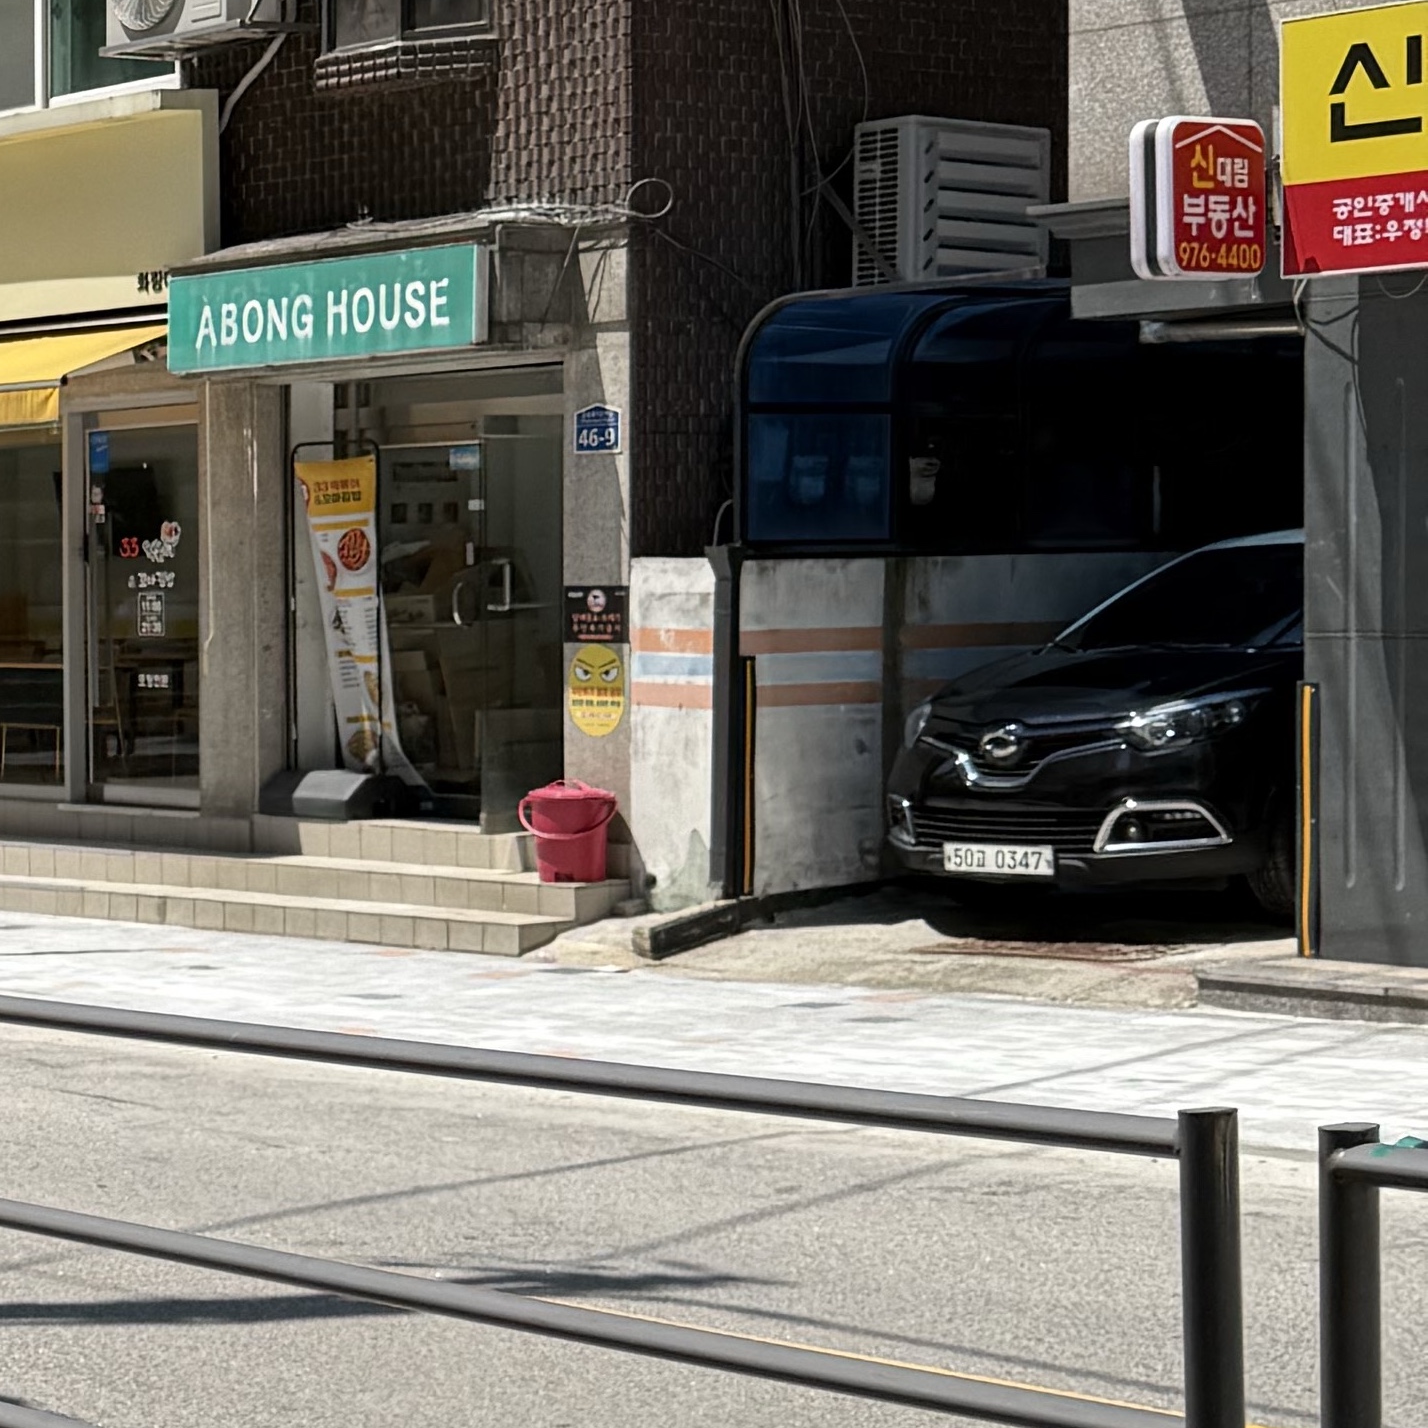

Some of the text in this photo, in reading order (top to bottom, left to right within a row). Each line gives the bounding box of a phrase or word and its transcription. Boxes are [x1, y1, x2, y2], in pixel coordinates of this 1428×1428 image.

[1328, 34, 1422, 143] 신
[1190, 143, 1249, 189] 신대림
[1182, 193, 1256, 239] 부동산
[1332, 217, 1428, 246] 대표:우정
[195, 277, 450, 350] ABONG HOUSE
[578, 427, 616, 447] 46-9
[995, 850, 1043, 870] 0347
